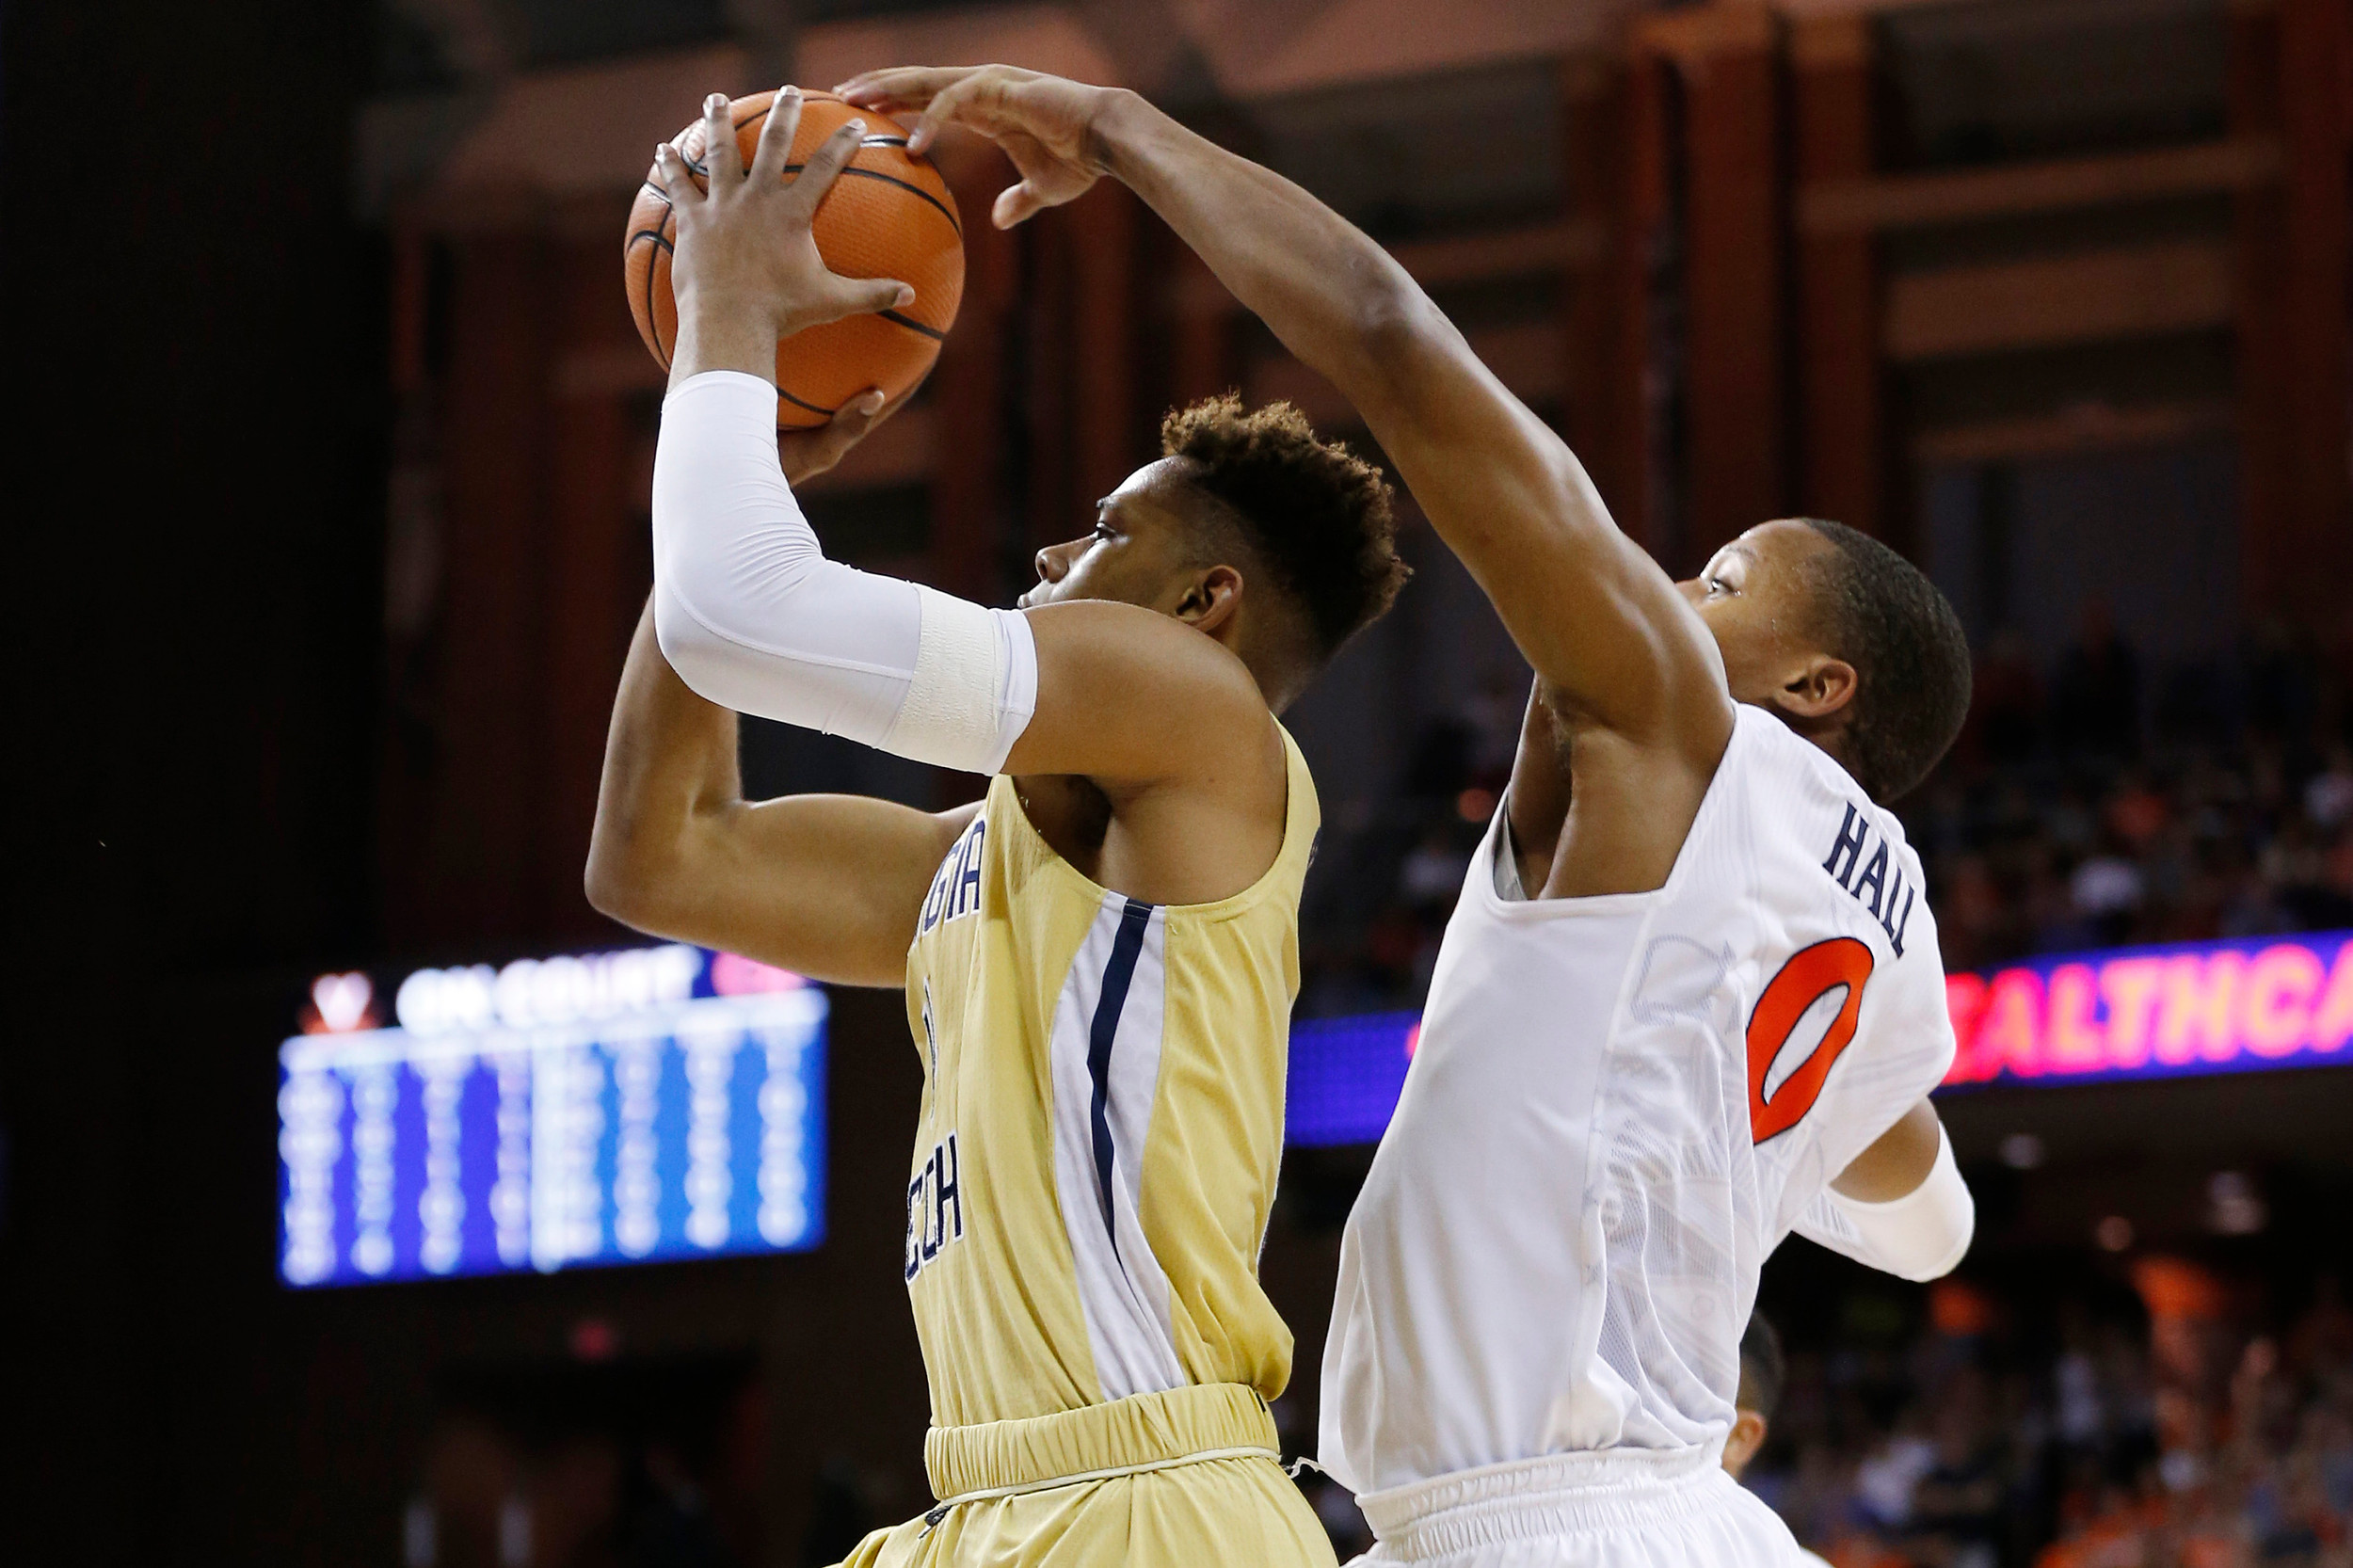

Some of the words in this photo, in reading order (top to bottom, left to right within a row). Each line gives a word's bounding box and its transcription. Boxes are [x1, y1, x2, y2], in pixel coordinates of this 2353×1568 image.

[912, 815, 986, 945] GIA
[1822, 800, 1915, 959] HALL
[1746, 936, 1874, 1145] 0
